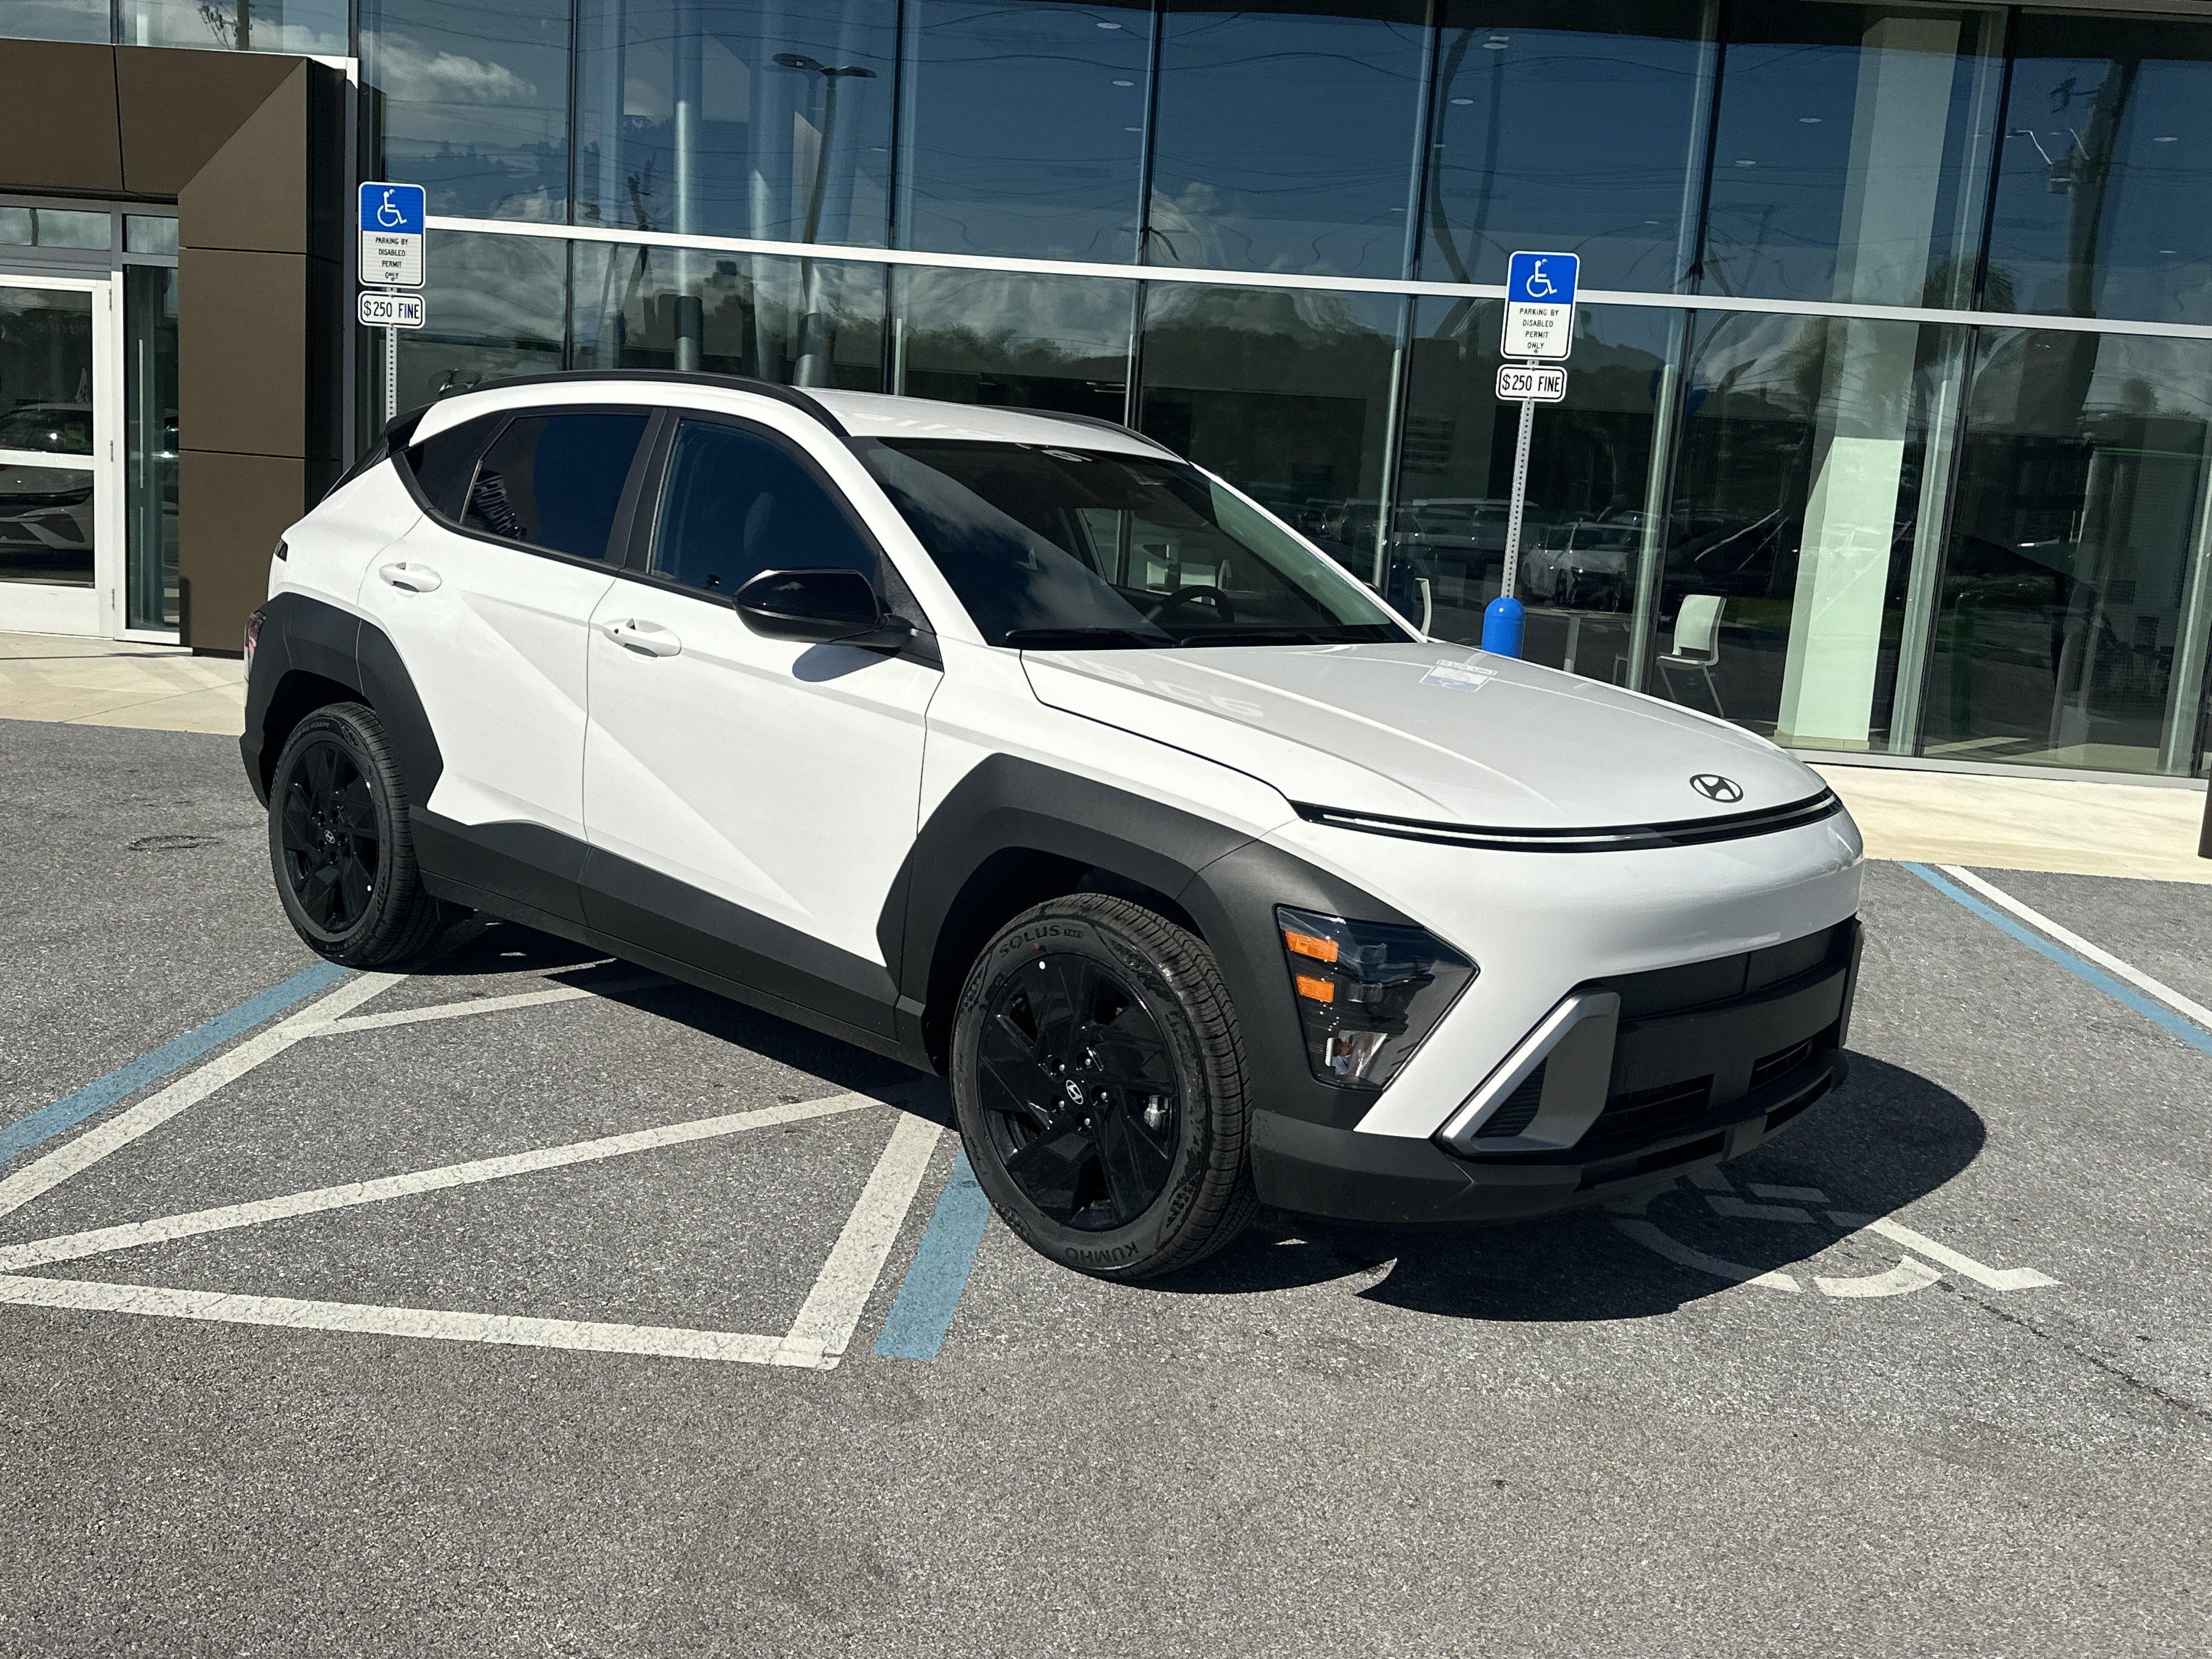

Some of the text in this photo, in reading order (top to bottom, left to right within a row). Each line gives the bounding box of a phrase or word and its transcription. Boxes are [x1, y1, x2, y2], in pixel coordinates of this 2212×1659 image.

[363, 300, 420, 319] $250 FINE
[1519, 308, 1548, 316] PARKING
[1522, 319, 1554, 328] DISABLED
[1502, 373, 1561, 393] $250 FINE
[999, 924, 1060, 958] SOLUS
[1064, 1241, 1139, 1263] KUMHO
